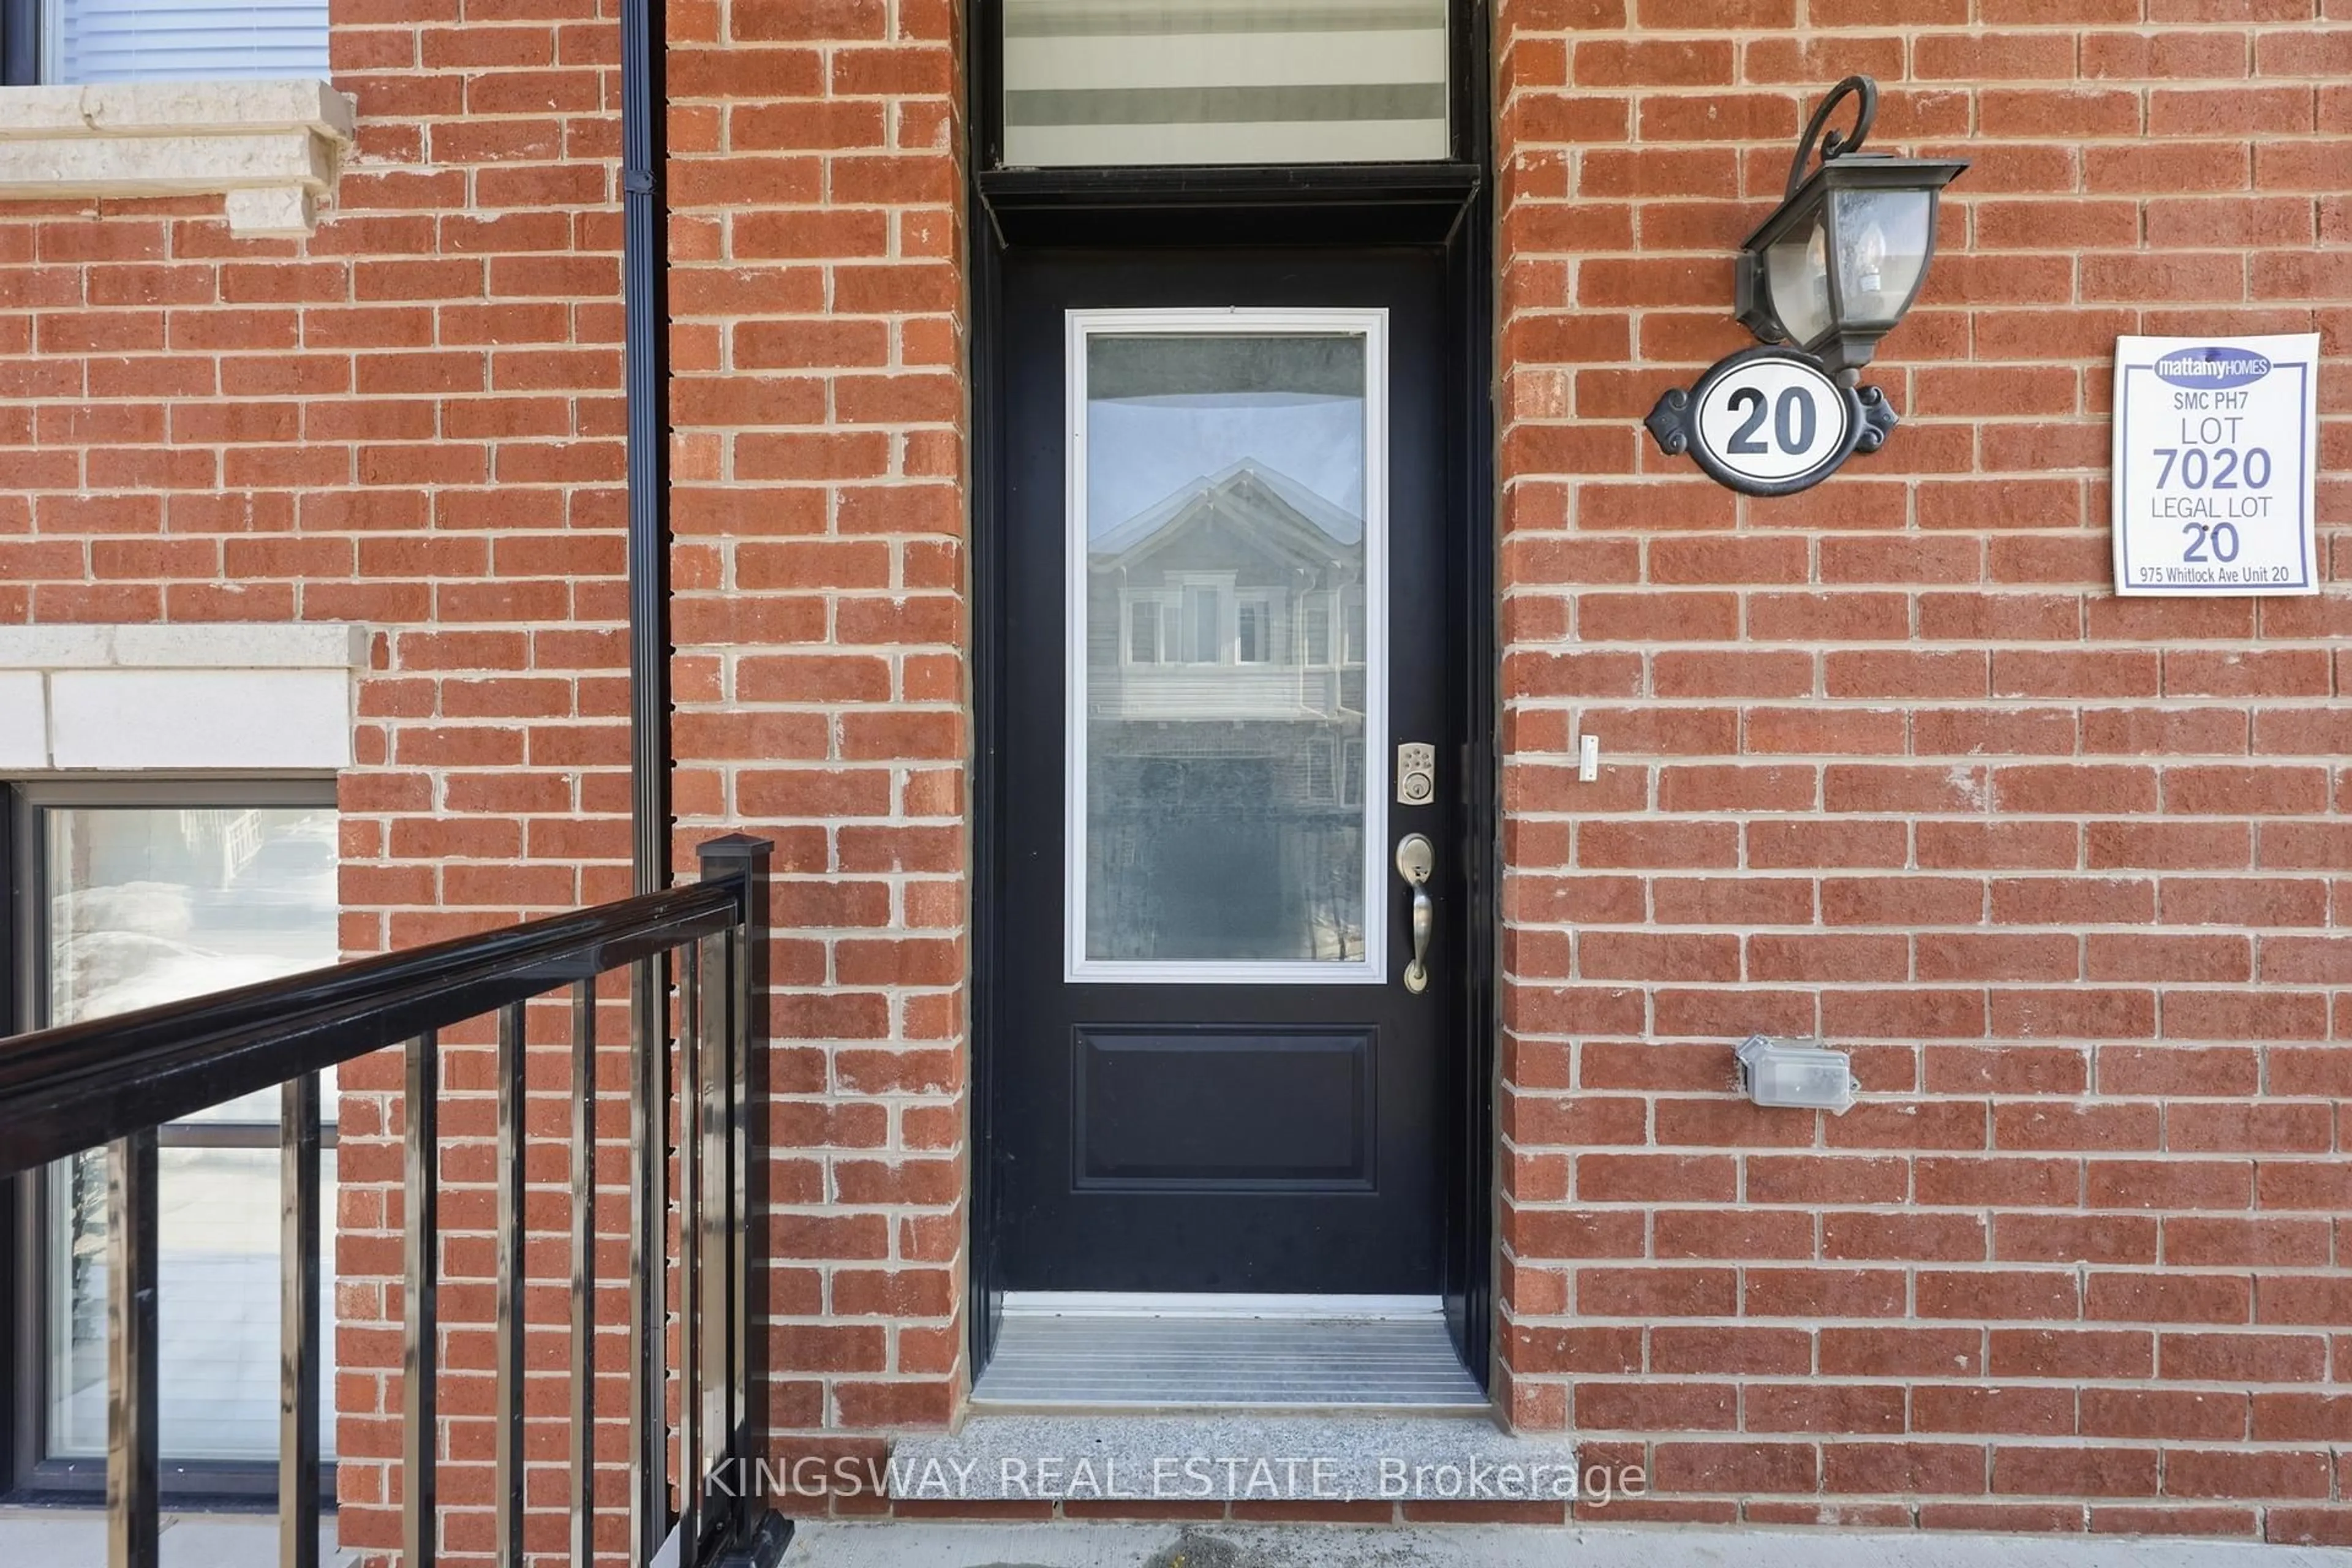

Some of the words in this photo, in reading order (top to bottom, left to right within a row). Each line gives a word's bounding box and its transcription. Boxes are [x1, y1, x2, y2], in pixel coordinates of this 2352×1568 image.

[2174, 392, 2209, 410] SMC
[2215, 391, 2248, 410] PH7
[1727, 386, 1817, 455] 20
[2182, 417, 2243, 444] LOT
[2153, 448, 2271, 489] 7020
[2152, 497, 2221, 518] LEGAL
[2229, 496, 2272, 518] LOT
[2182, 522, 2239, 562] 20
[2140, 567, 2163, 582] 975
[2166, 567, 2214, 582] Whitlock
[2218, 568, 2239, 582] Ave
[2243, 567, 2267, 581] Unit
[2271, 567, 2289, 581] 20
